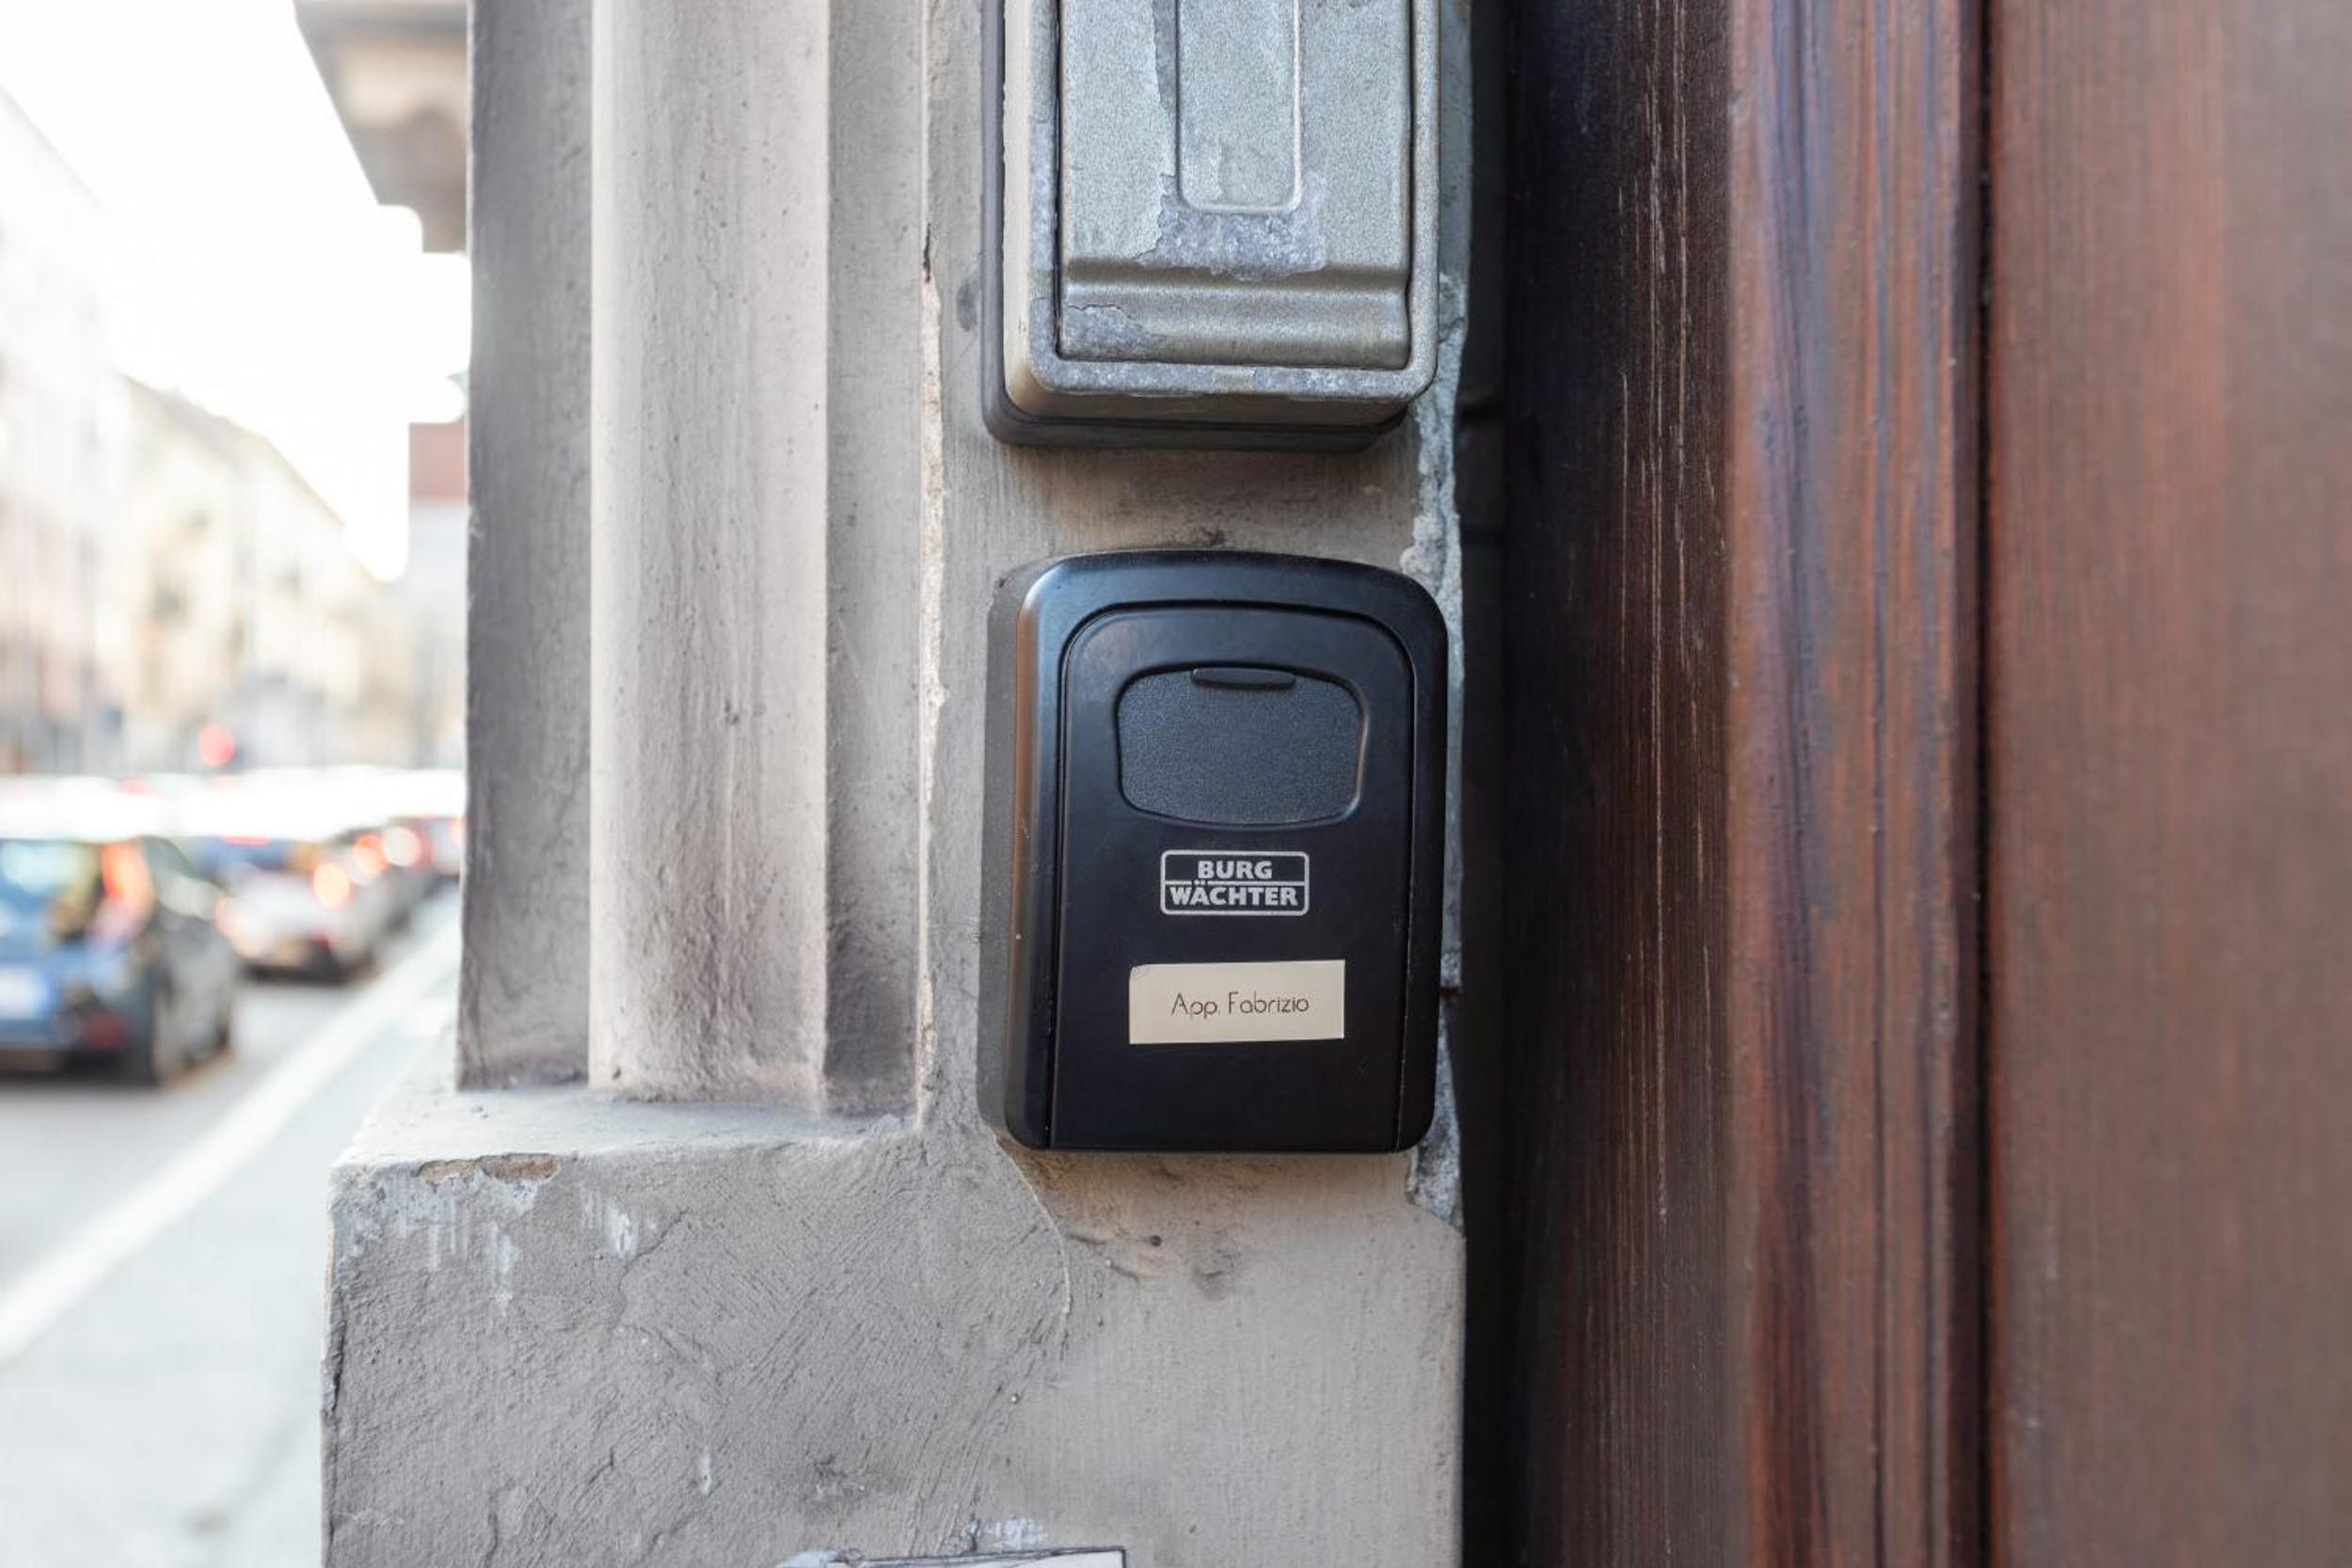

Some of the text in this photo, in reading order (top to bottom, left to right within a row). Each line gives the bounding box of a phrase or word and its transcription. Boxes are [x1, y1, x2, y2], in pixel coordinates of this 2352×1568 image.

[1198, 861, 1272, 879] BURG
[1169, 879, 1298, 906] WÄCHTER
[1228, 990, 1310, 1014] Fabrizio
